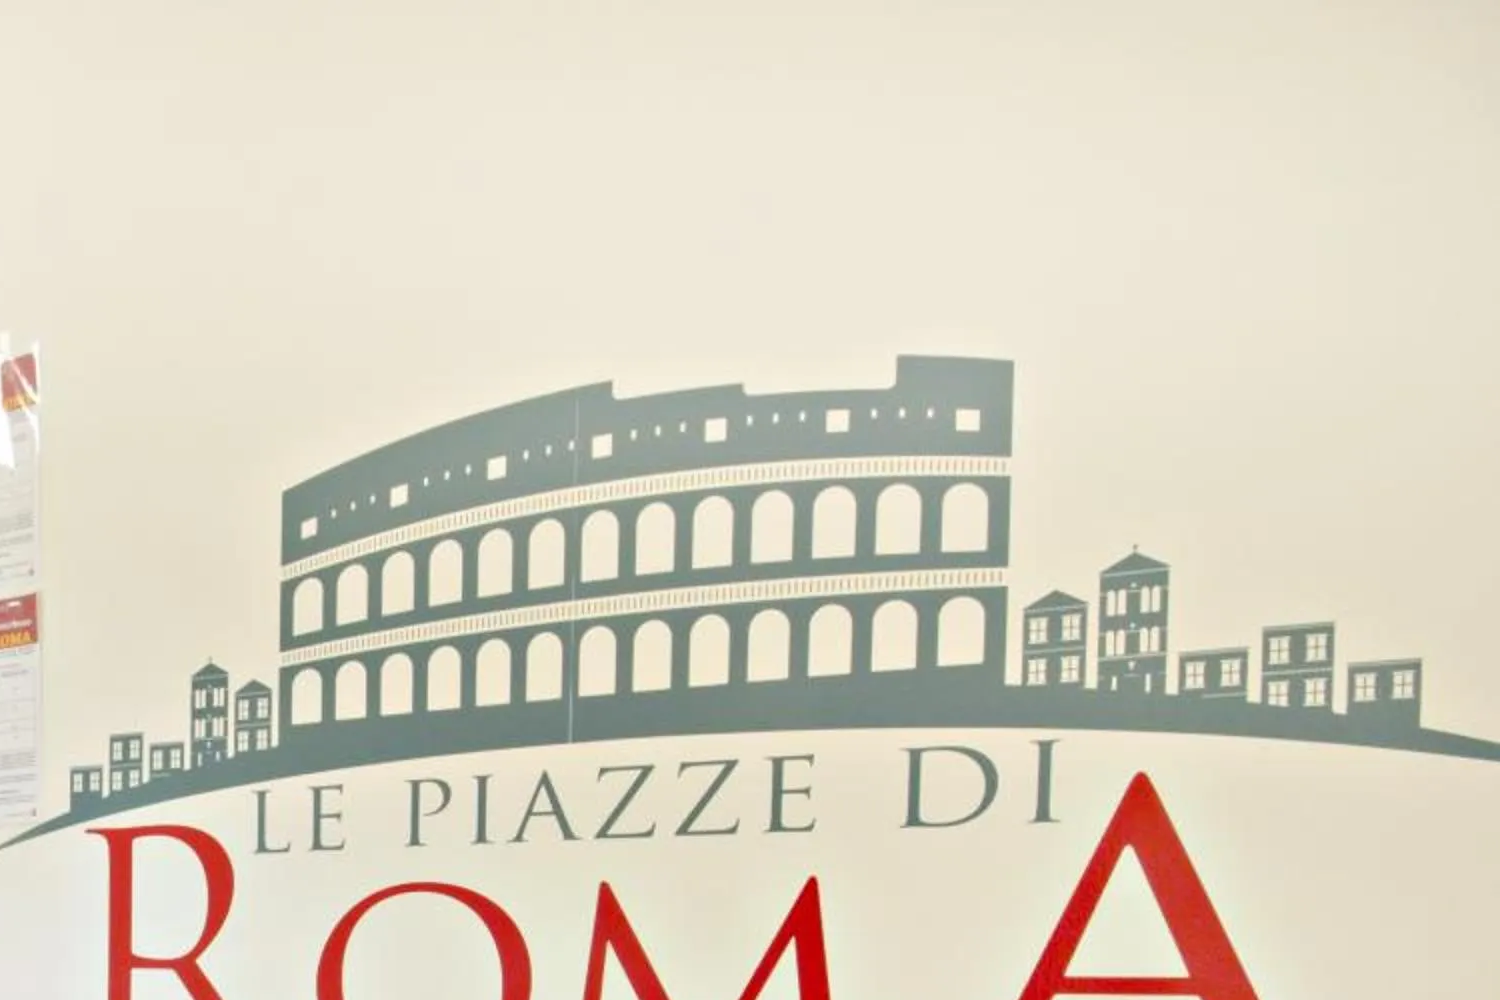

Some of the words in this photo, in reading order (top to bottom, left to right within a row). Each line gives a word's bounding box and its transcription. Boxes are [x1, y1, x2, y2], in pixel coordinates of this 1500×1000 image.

[252, 789, 346, 854] LE
[406, 753, 817, 848] PIAZZE
[901, 740, 1061, 829] DI
